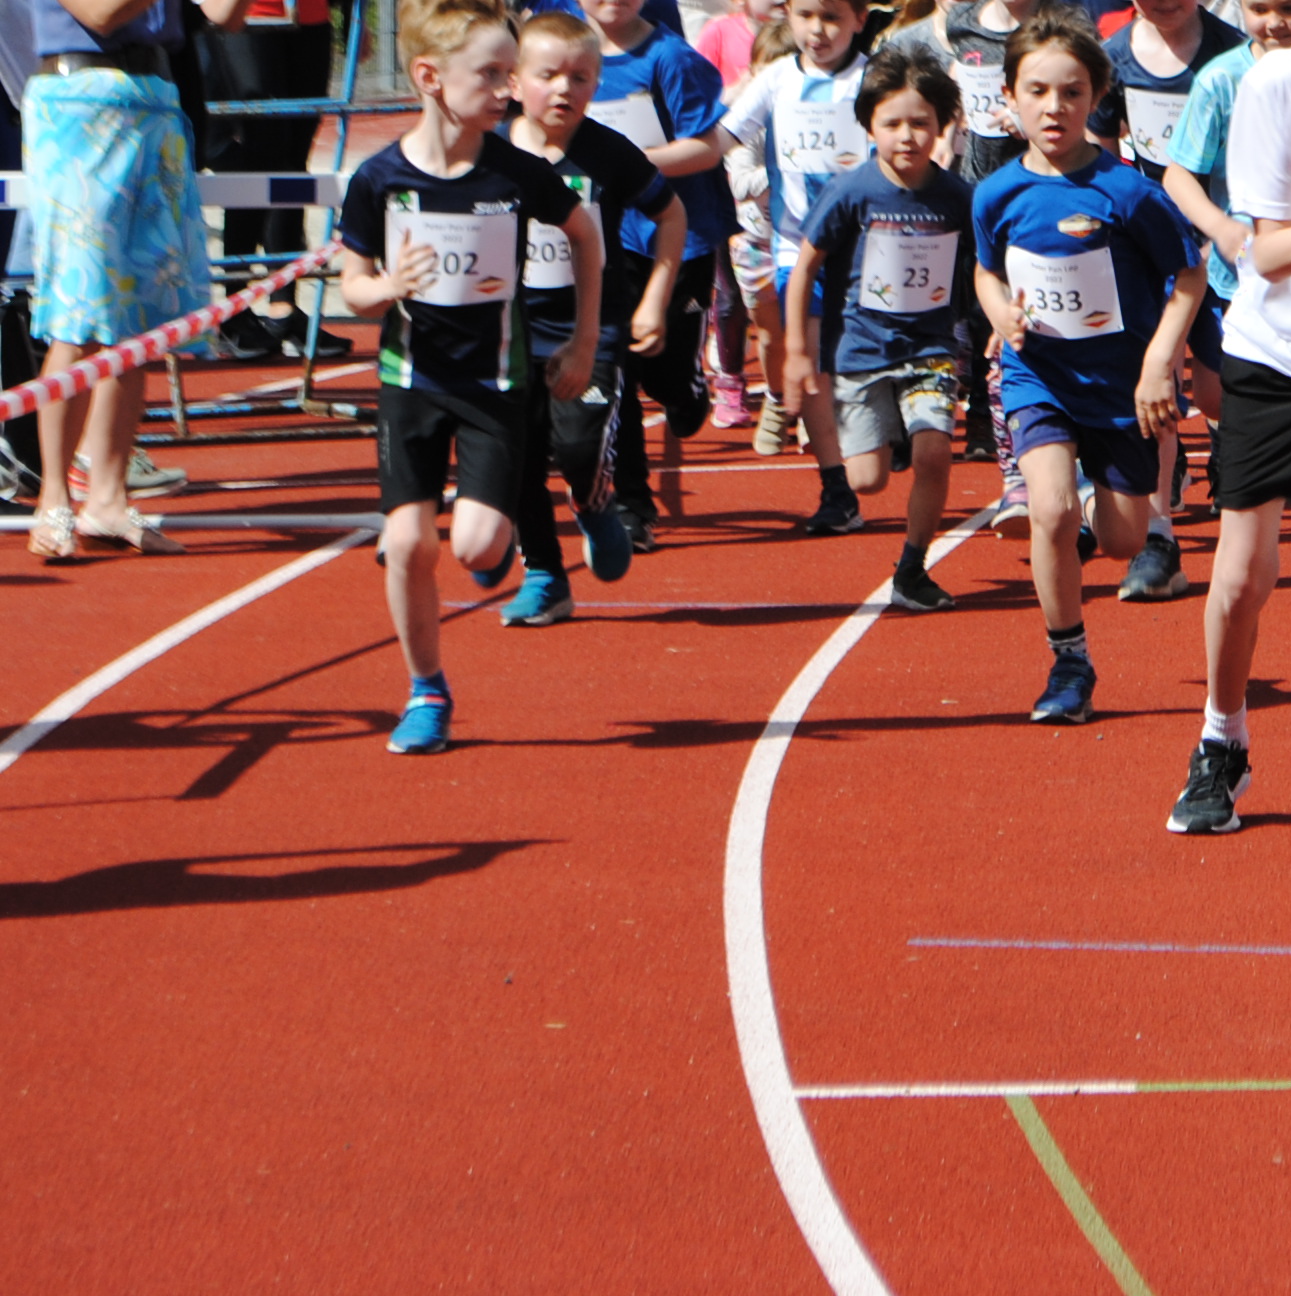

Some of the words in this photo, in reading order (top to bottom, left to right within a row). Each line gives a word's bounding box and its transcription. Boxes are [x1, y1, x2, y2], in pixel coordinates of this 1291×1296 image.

[971, 94, 1007, 113] 225
[798, 131, 838, 150] 124
[527, 242, 571, 263] 203
[903, 267, 930, 288] 23
[1035, 288, 1083, 313] 333
